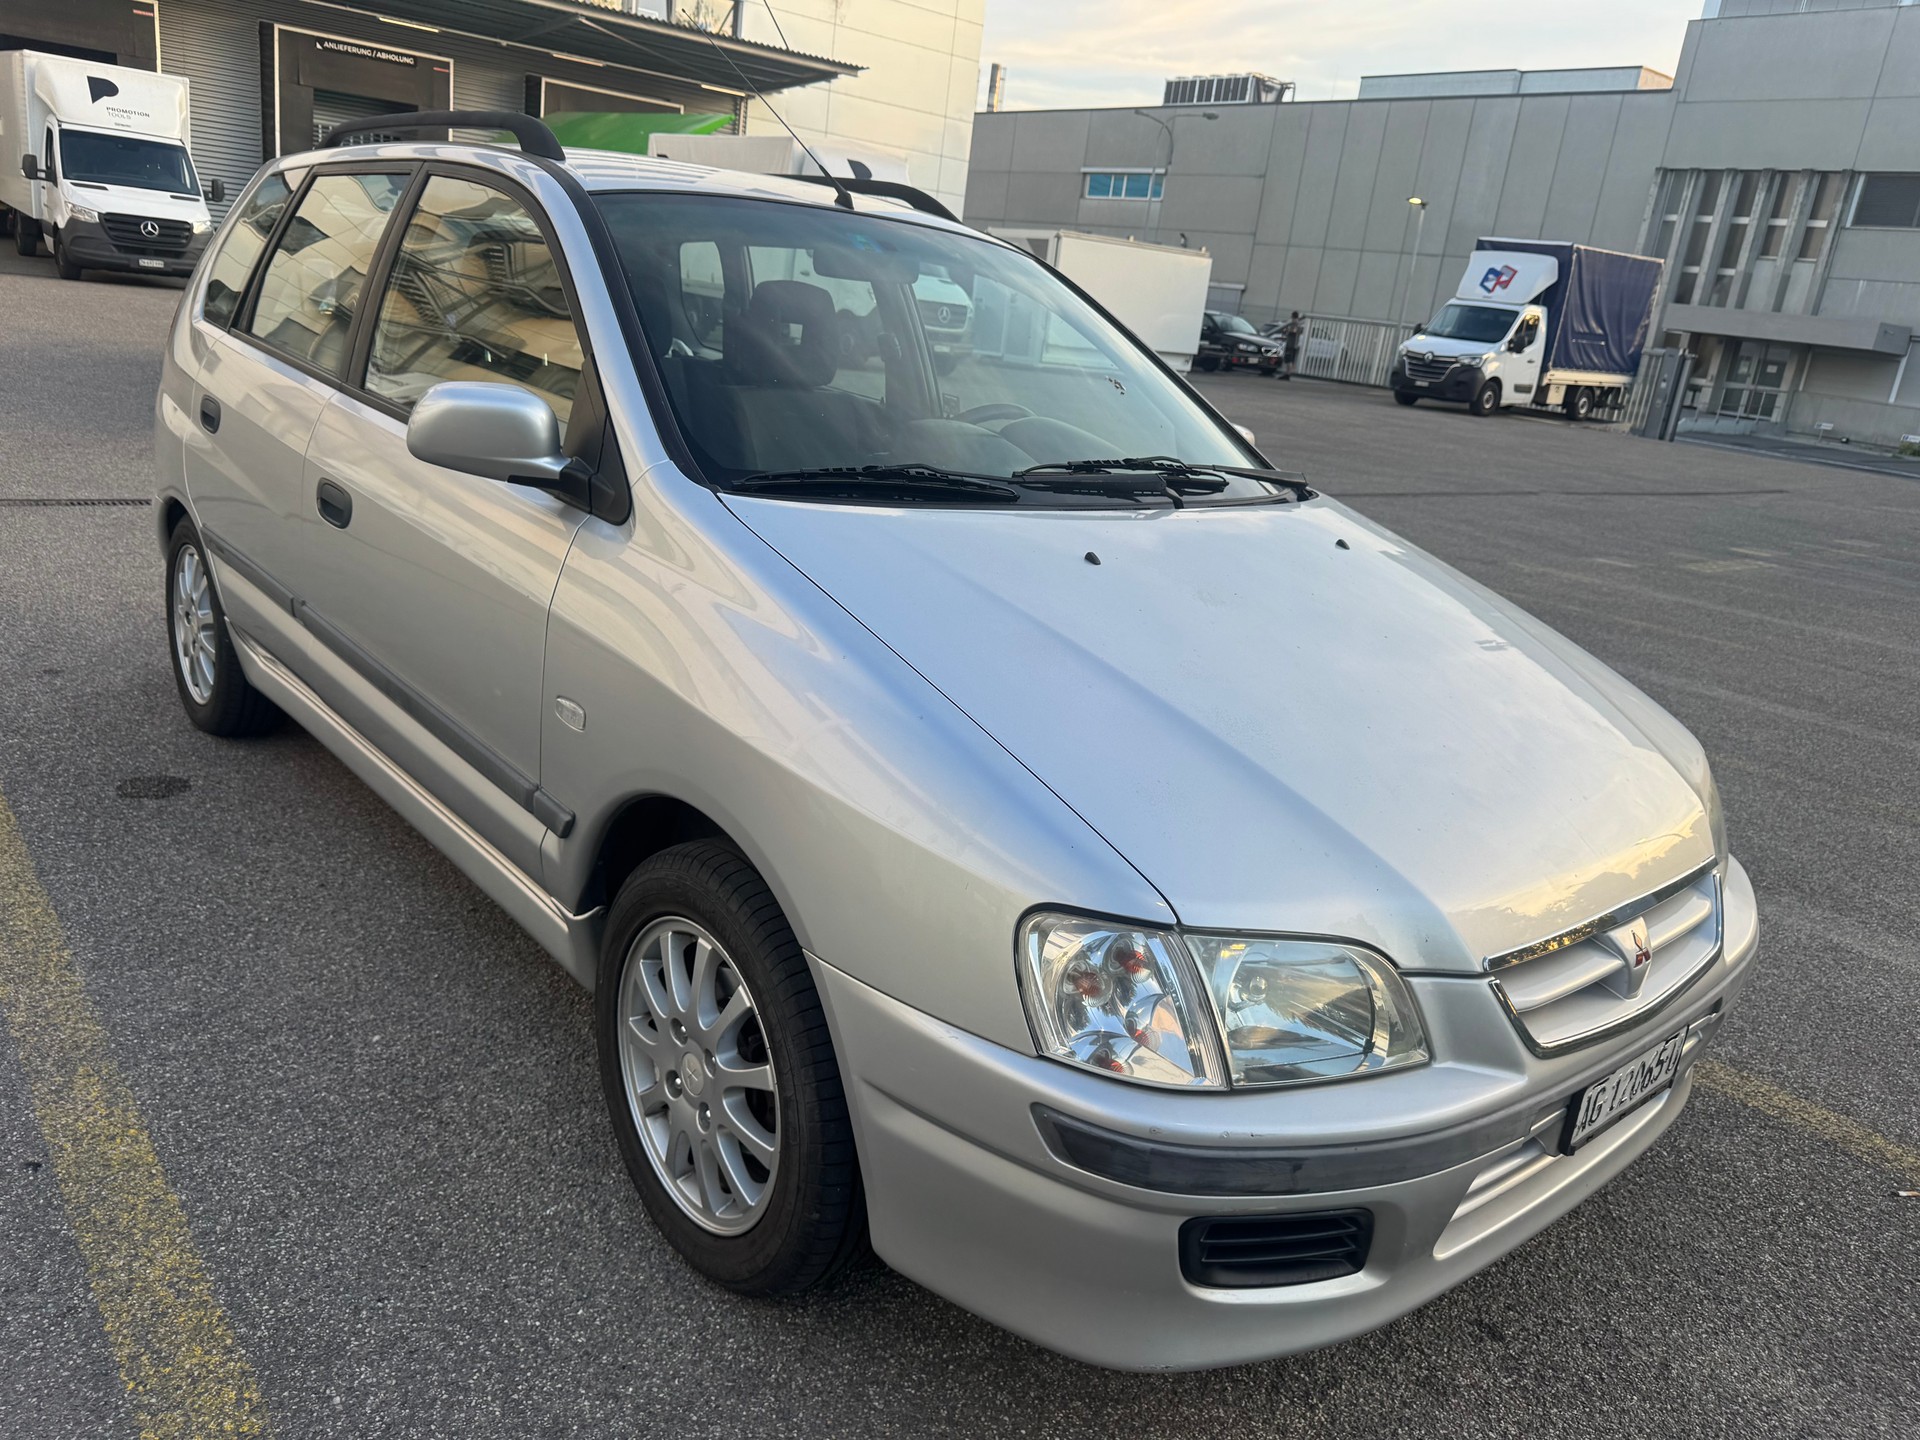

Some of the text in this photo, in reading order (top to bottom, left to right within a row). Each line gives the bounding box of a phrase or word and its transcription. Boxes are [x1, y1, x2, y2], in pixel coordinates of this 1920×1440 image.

[323, 41, 372, 58] ANLIEFERUNG
[377, 51, 415, 65] ABHOLUNG
[106, 106, 150, 118] PROMOTION
